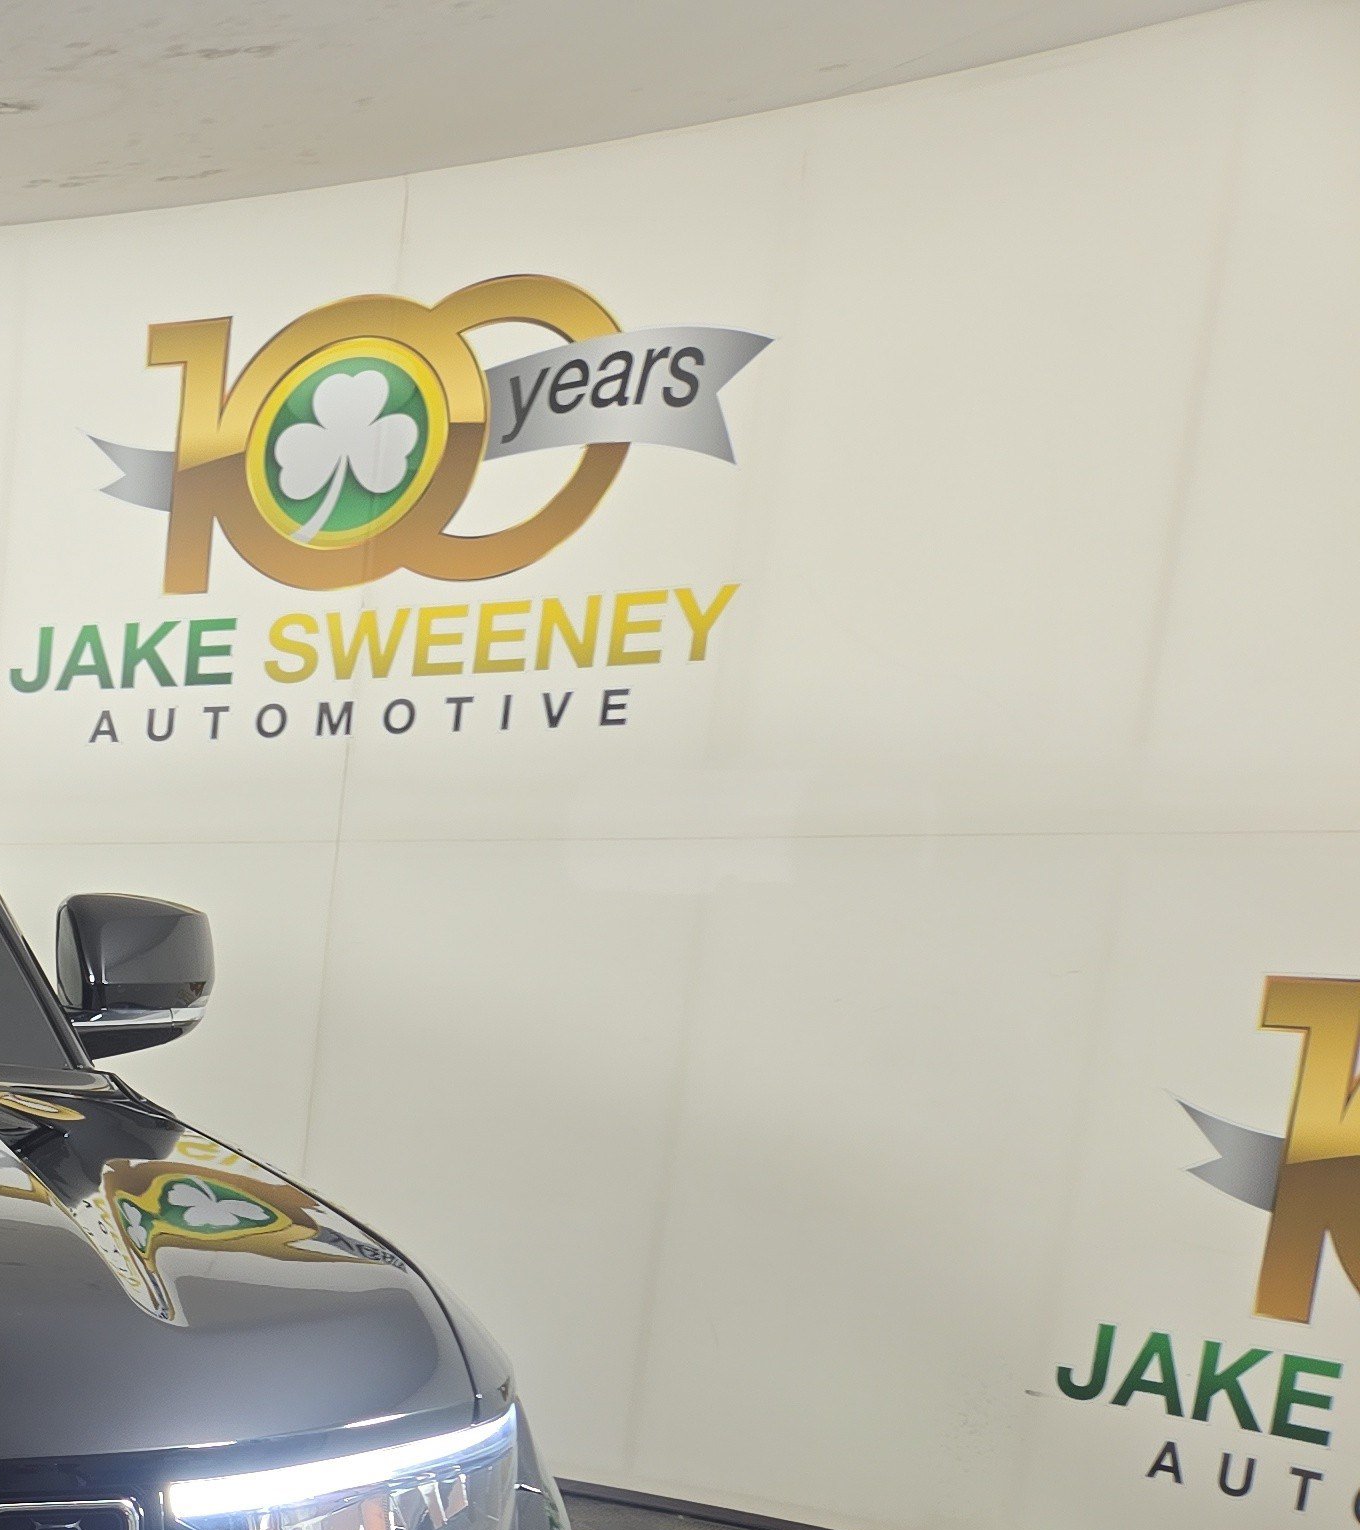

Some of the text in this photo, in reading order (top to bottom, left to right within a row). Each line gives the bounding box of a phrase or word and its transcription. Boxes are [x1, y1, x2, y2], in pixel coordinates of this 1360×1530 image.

[501, 345, 705, 443] years
[10, 584, 741, 694] JAKE SWEENEY
[89, 688, 632, 745] AUTOMOTIVE
[1055, 1323, 1344, 1447] JAKE
[1145, 1440, 1360, 1525] AUT
